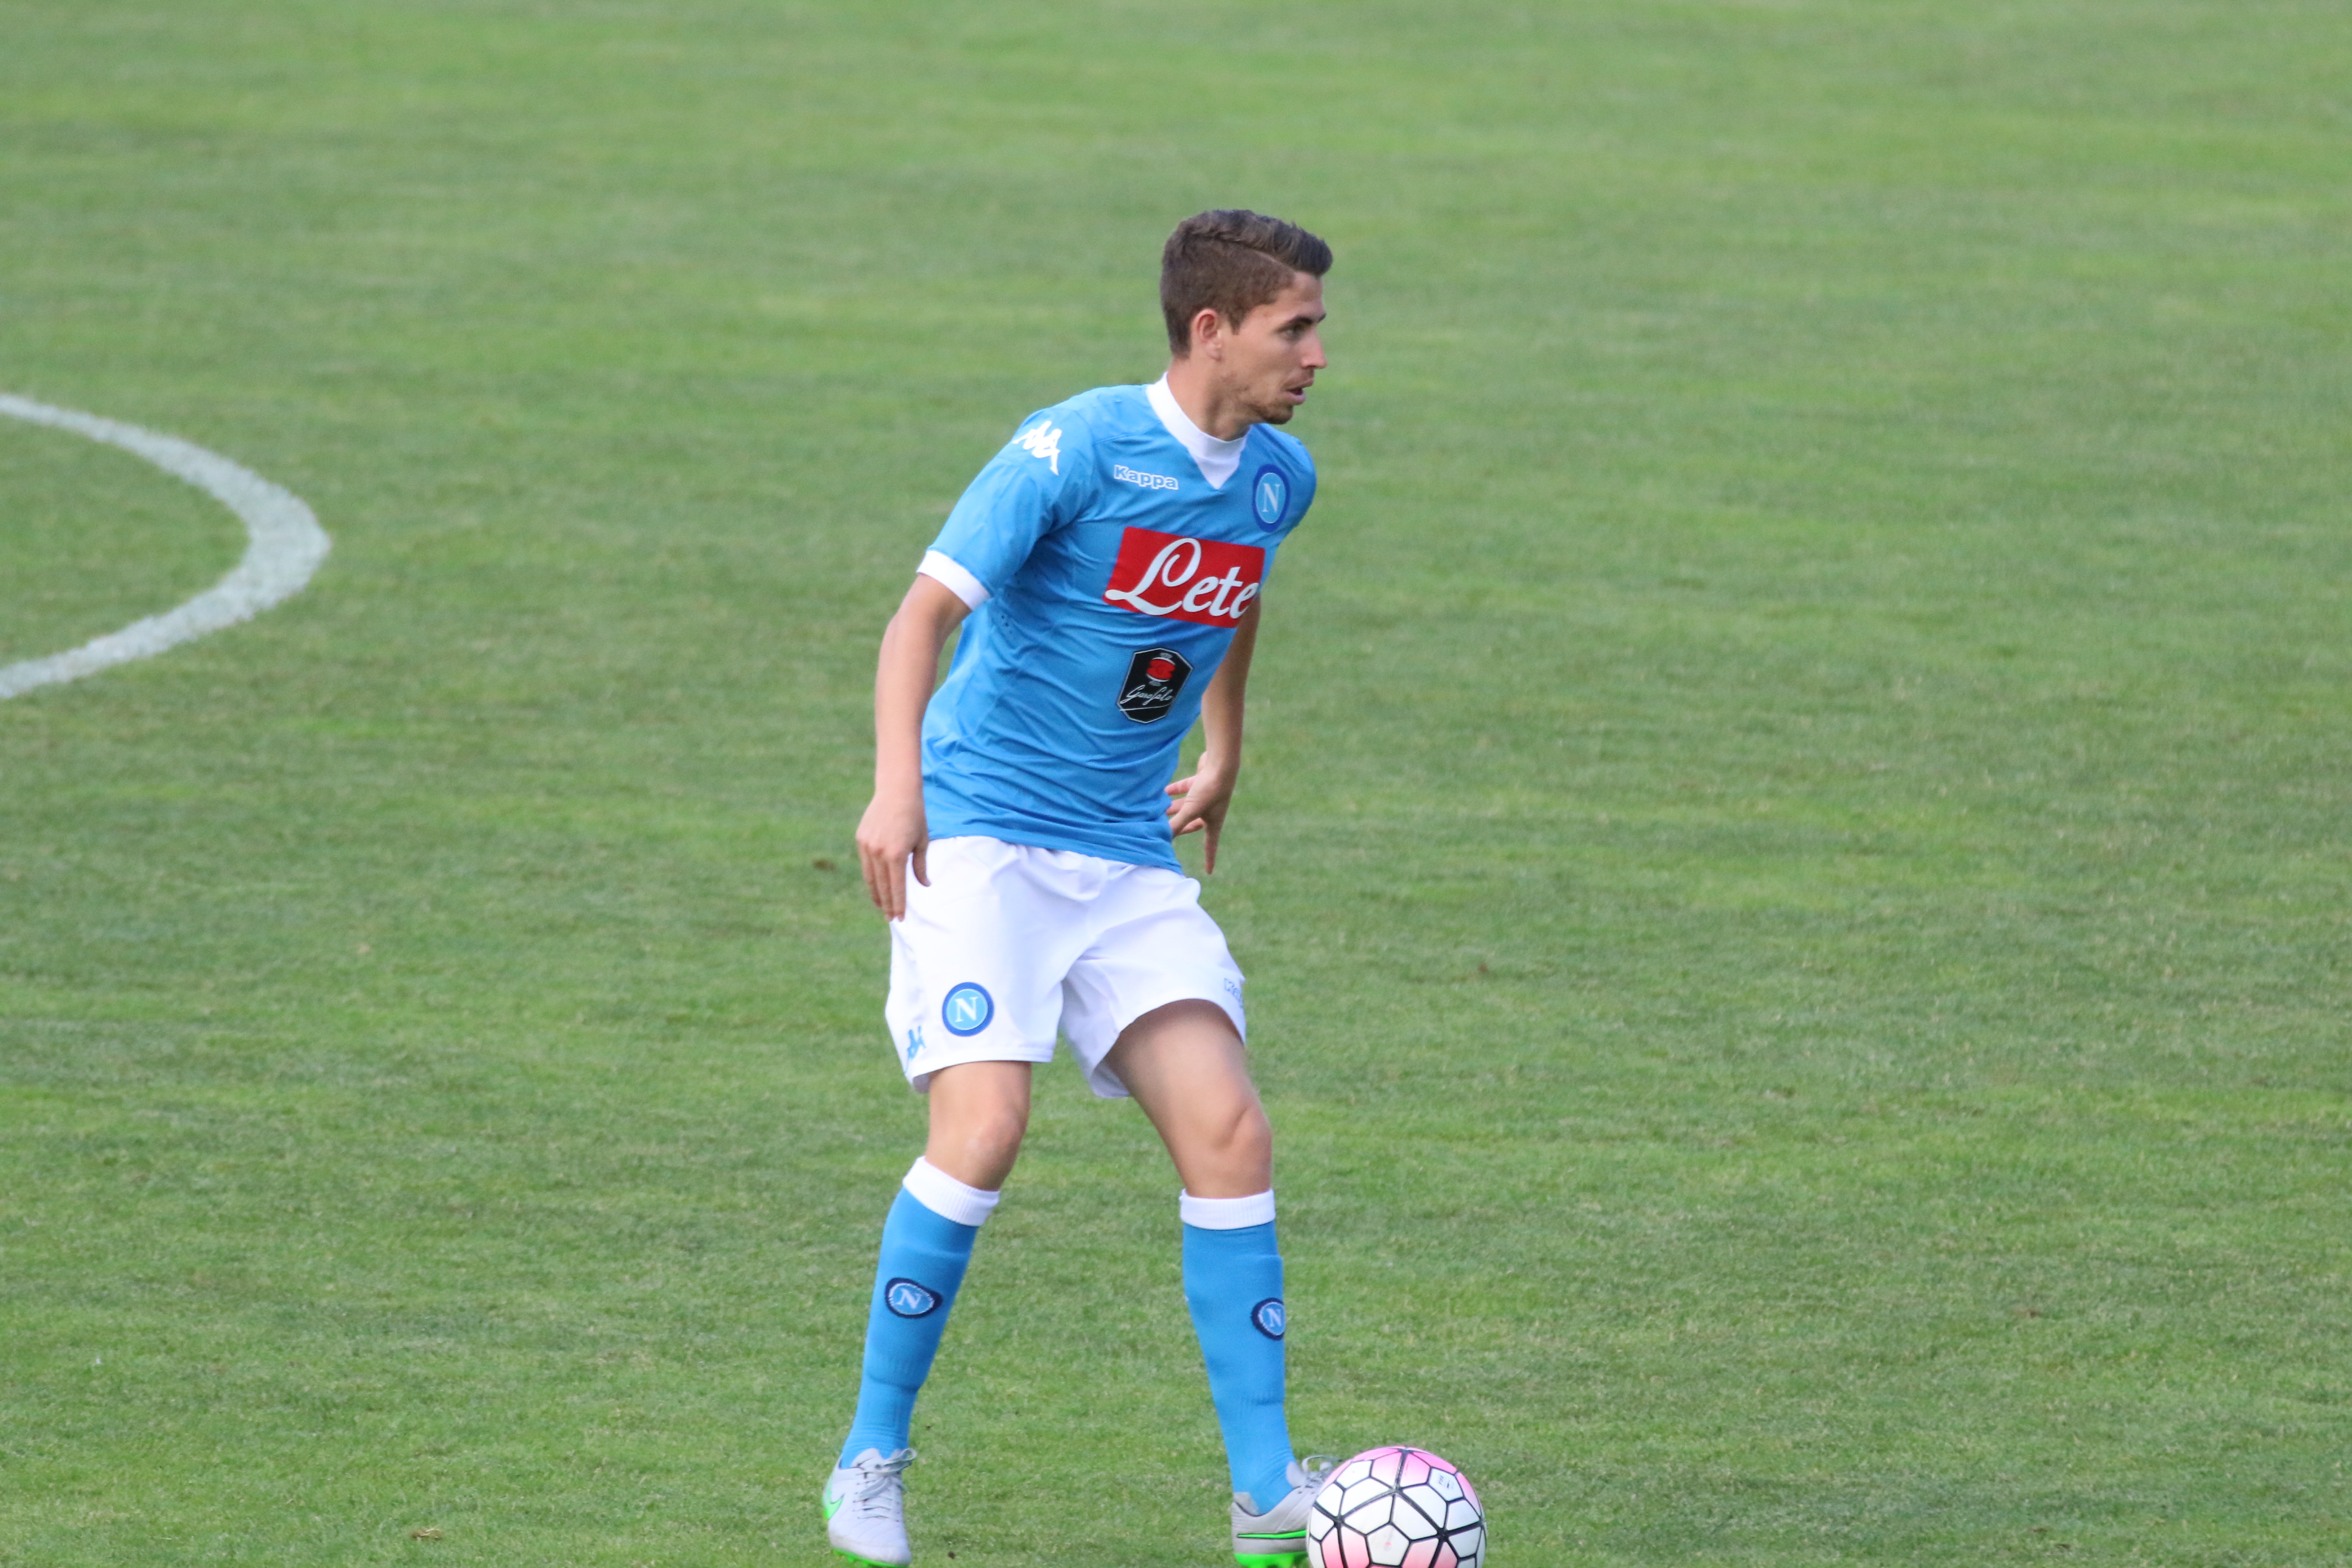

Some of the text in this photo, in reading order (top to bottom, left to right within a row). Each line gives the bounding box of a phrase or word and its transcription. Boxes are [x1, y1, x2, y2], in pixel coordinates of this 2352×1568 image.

[1113, 464, 1179, 490] Kappa
[1262, 483, 1281, 513] N
[1104, 538, 1259, 619] Lete
[954, 996, 979, 1023] N
[896, 1288, 922, 1309] N
[1266, 1308, 1282, 1327] N
